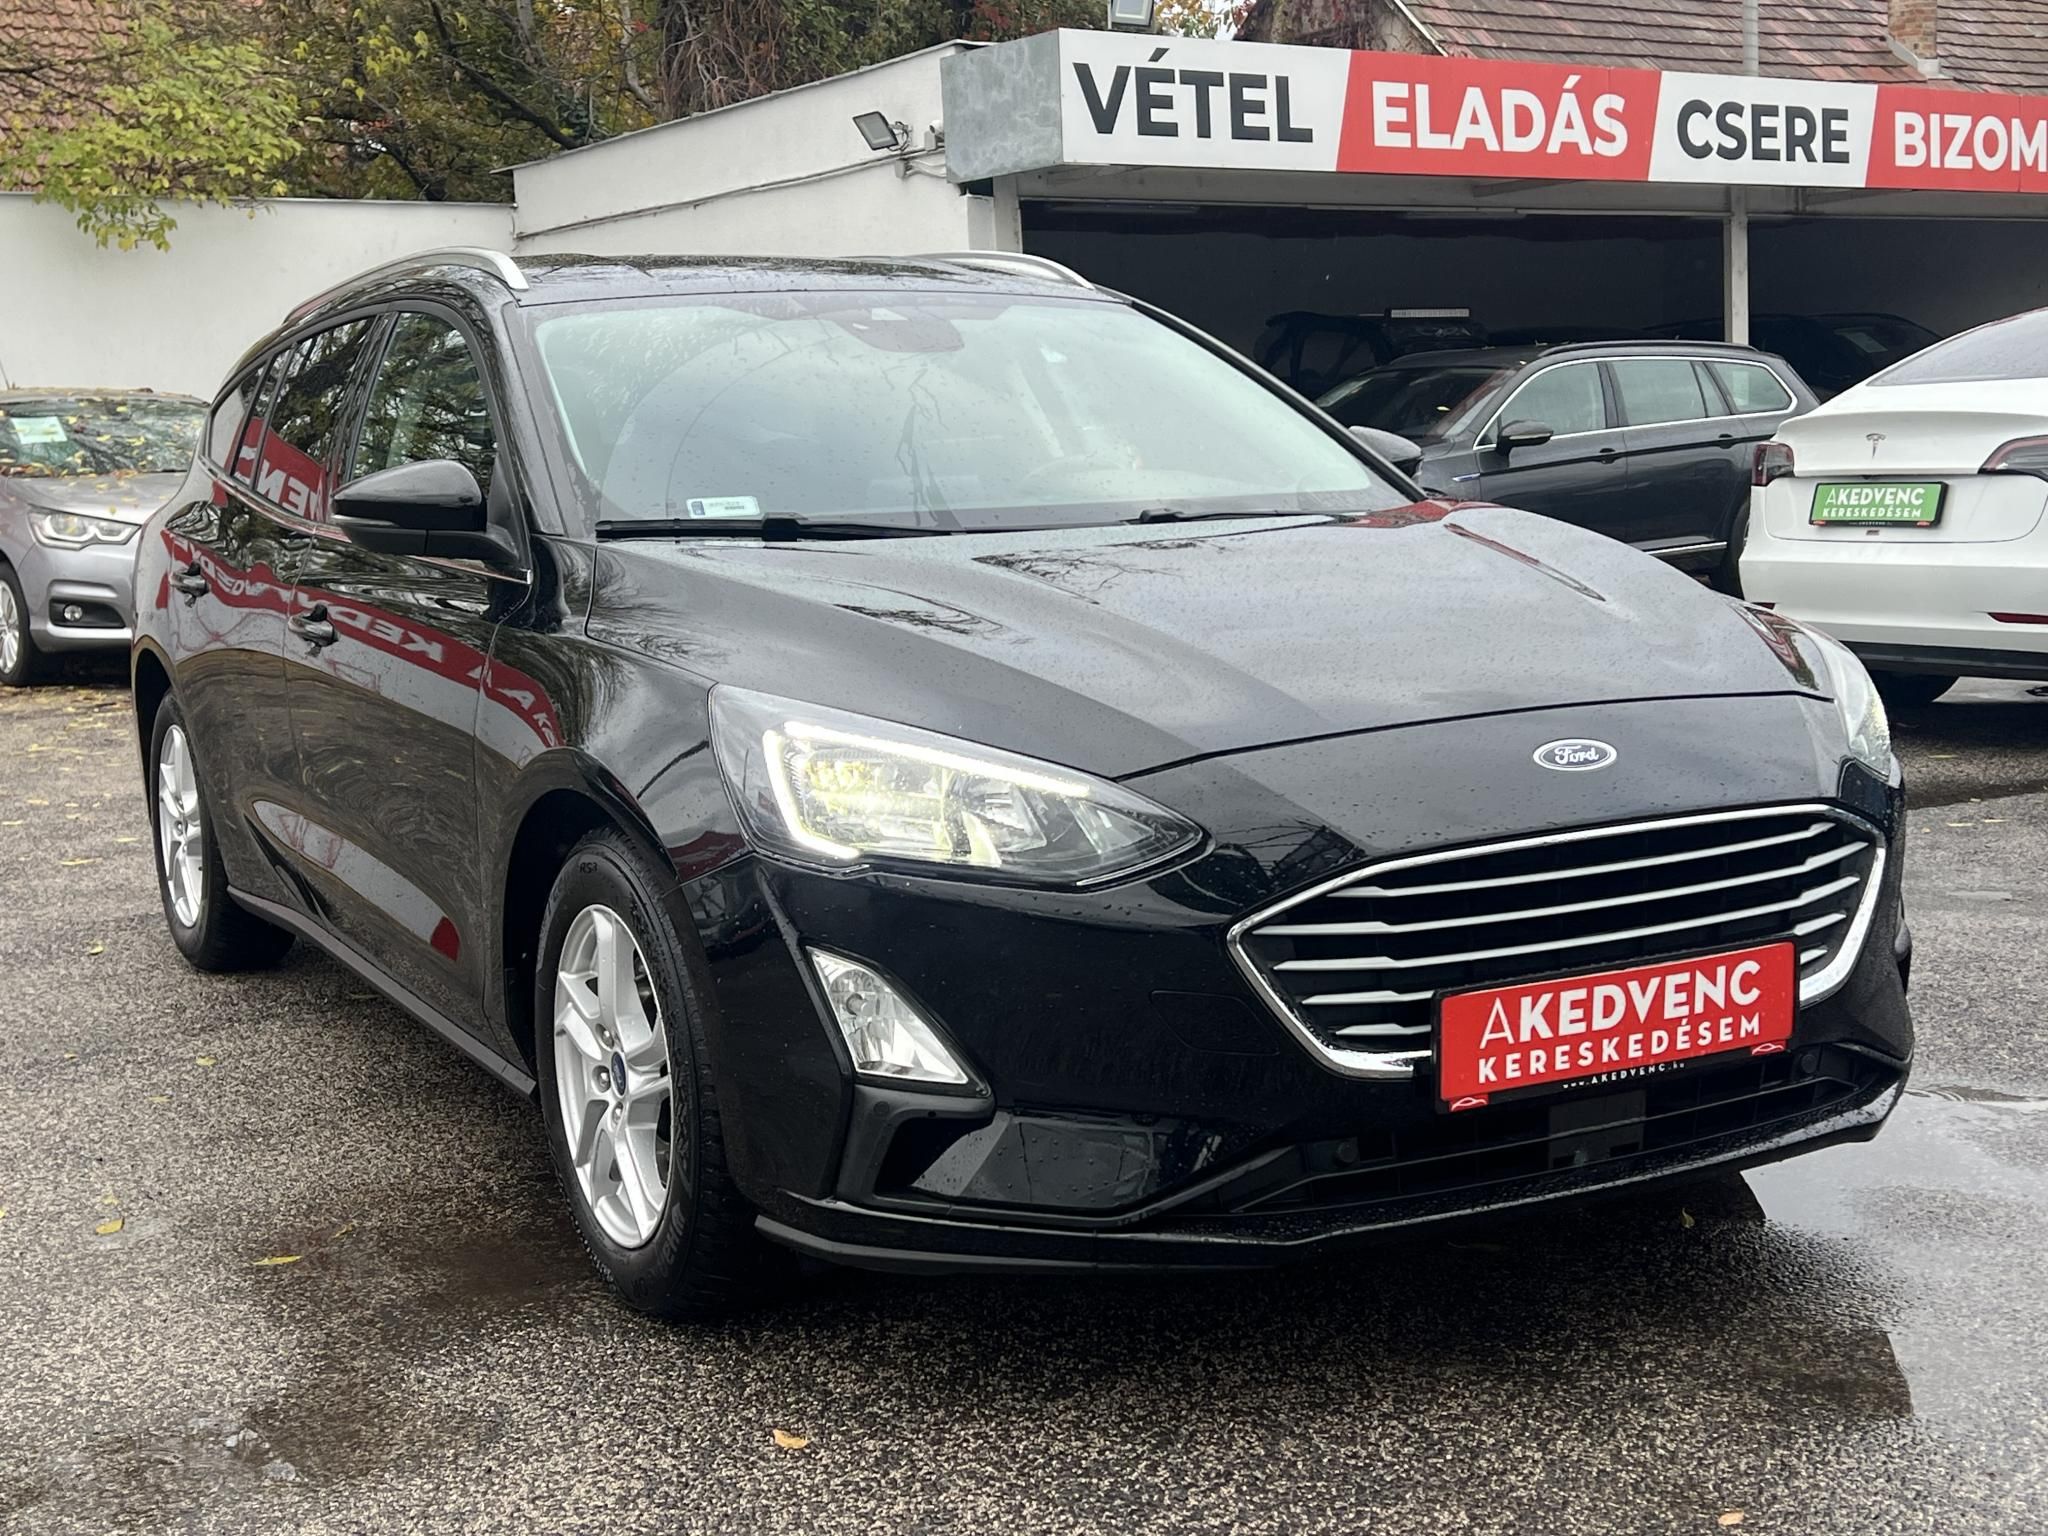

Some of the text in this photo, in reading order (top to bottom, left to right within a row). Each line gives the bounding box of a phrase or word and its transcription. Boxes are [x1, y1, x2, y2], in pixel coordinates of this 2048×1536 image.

[1073, 48, 2048, 172] VÉTEL ELADÁS CSERE BIZOM
[1823, 506, 1922, 518] KERESKEDÉSEM
[1826, 487, 1925, 505] AKEDVENC
[1554, 745, 1600, 765] Ford
[1479, 960, 1761, 1049] AKEDVENC
[1478, 1012, 1761, 1084] KERESKEDÉSEM
